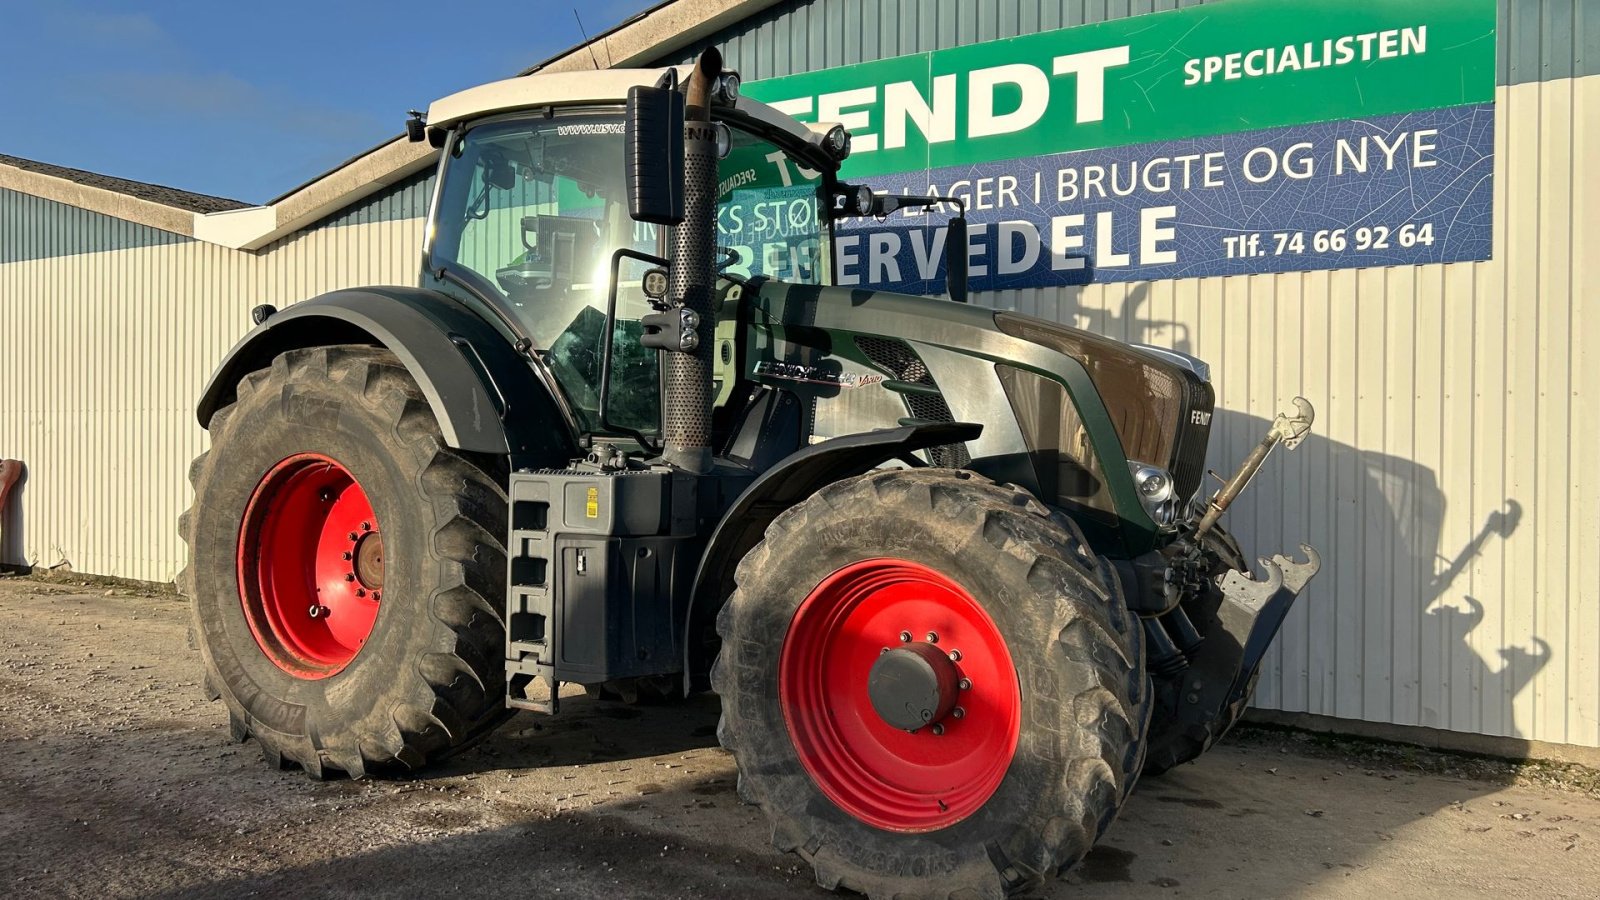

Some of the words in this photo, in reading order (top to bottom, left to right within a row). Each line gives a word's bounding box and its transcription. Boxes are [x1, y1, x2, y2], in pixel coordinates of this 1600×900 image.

[1184, 25, 1427, 86] SPECIALISTEN
[557, 120, 627, 136] www.usv.d
[903, 175, 1020, 217] LAGER
[1034, 172, 1042, 205] I
[1057, 152, 1225, 202] BRUGTE
[1243, 143, 1314, 184] OG
[1335, 129, 1439, 176] NYE
[1223, 236, 1266, 259] Tlf.
[1273, 232, 1305, 256] 74
[1313, 229, 1347, 253] 66
[1355, 226, 1389, 251] 92
[1399, 223, 1435, 248] 64
